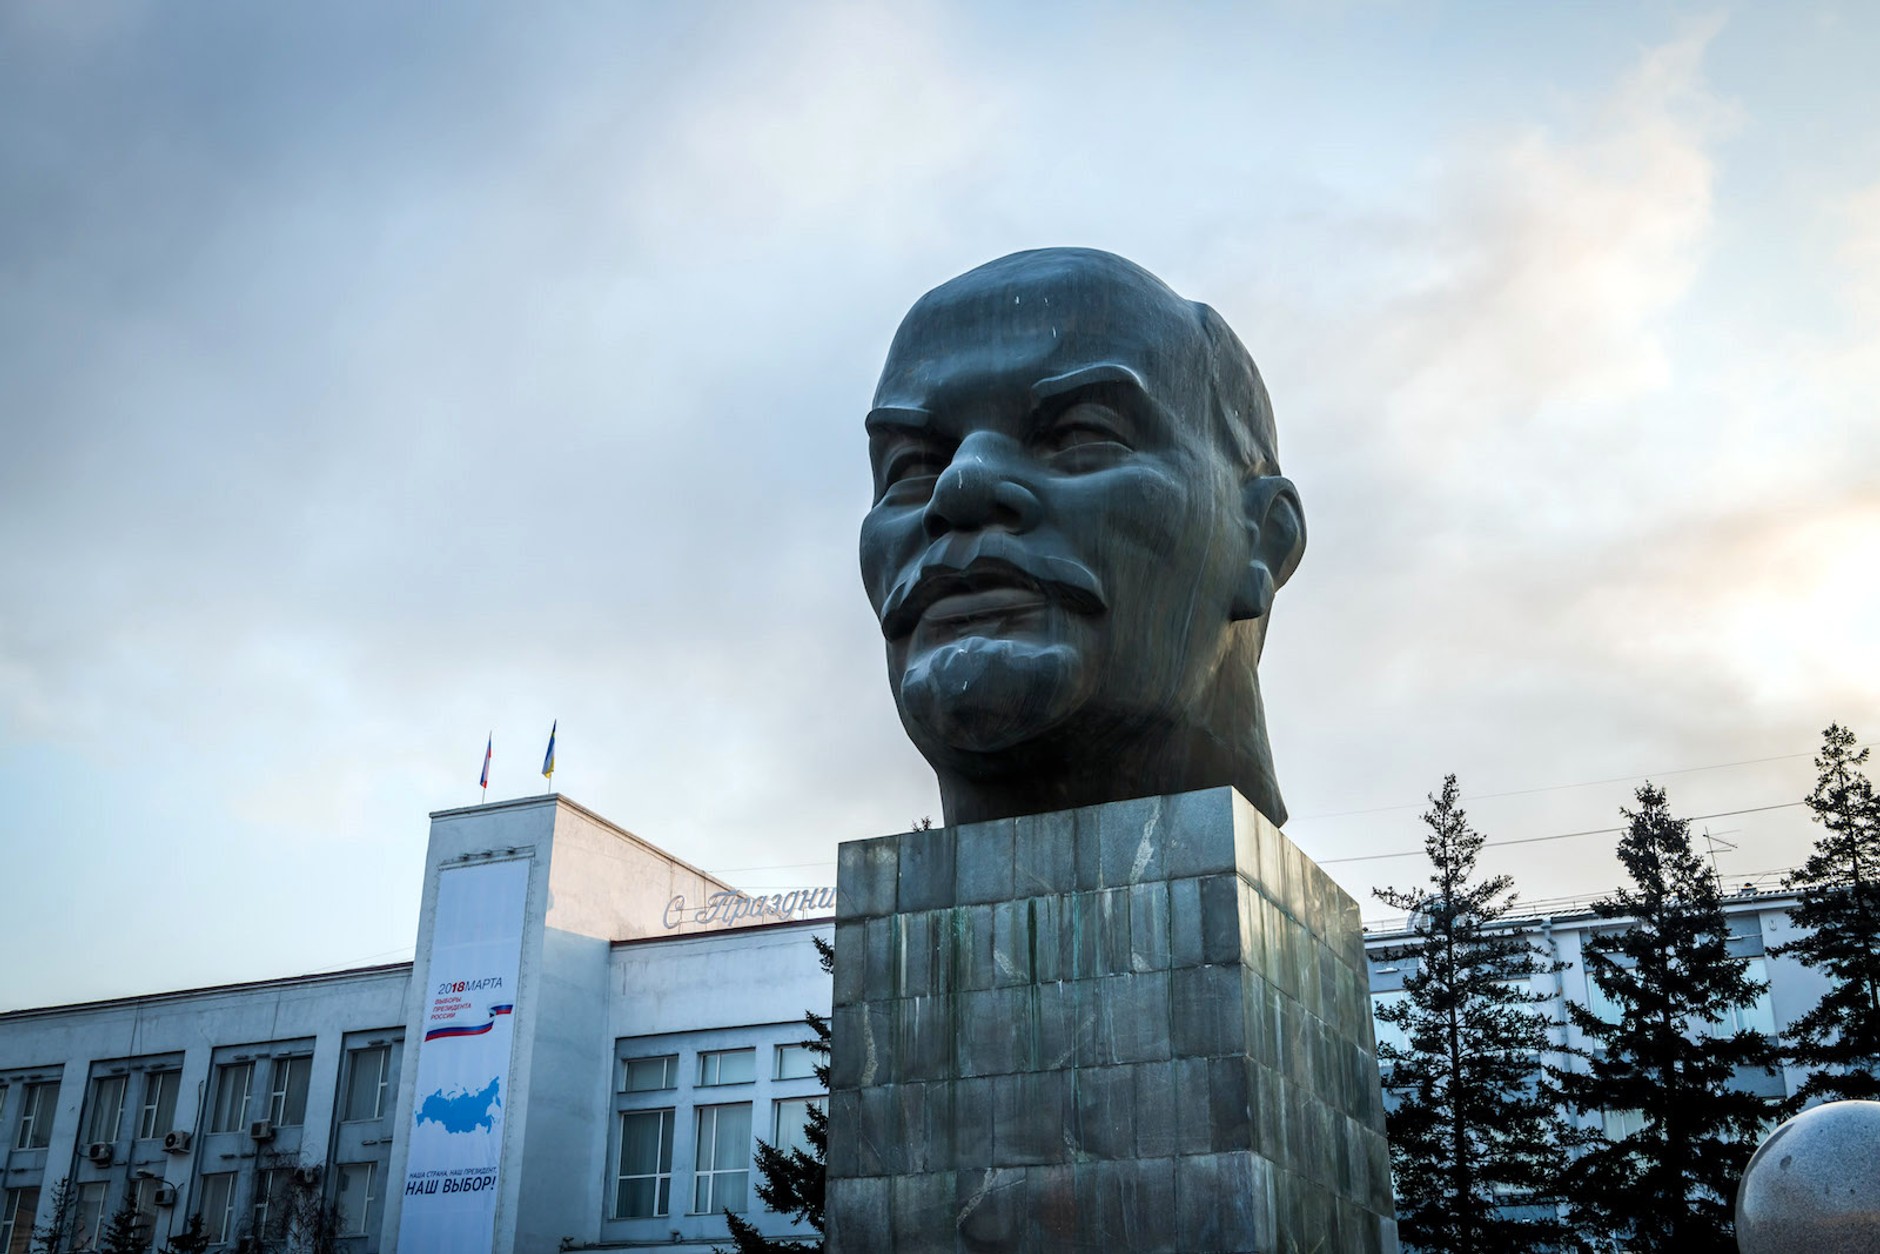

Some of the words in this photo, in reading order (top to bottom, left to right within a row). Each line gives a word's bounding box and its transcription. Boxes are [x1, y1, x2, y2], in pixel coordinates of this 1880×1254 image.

[663, 895, 685, 930] С
[434, 997, 462, 1005] ВЫБОРЫ
[433, 1003, 472, 1012] ПРЕЗИДЕНТА
[431, 1012, 456, 1020] РОССИИ
[449, 1168, 464, 1176] НАШ
[405, 1179, 439, 1195] НАШ
[443, 1176, 496, 1193] ВЫБОР!
